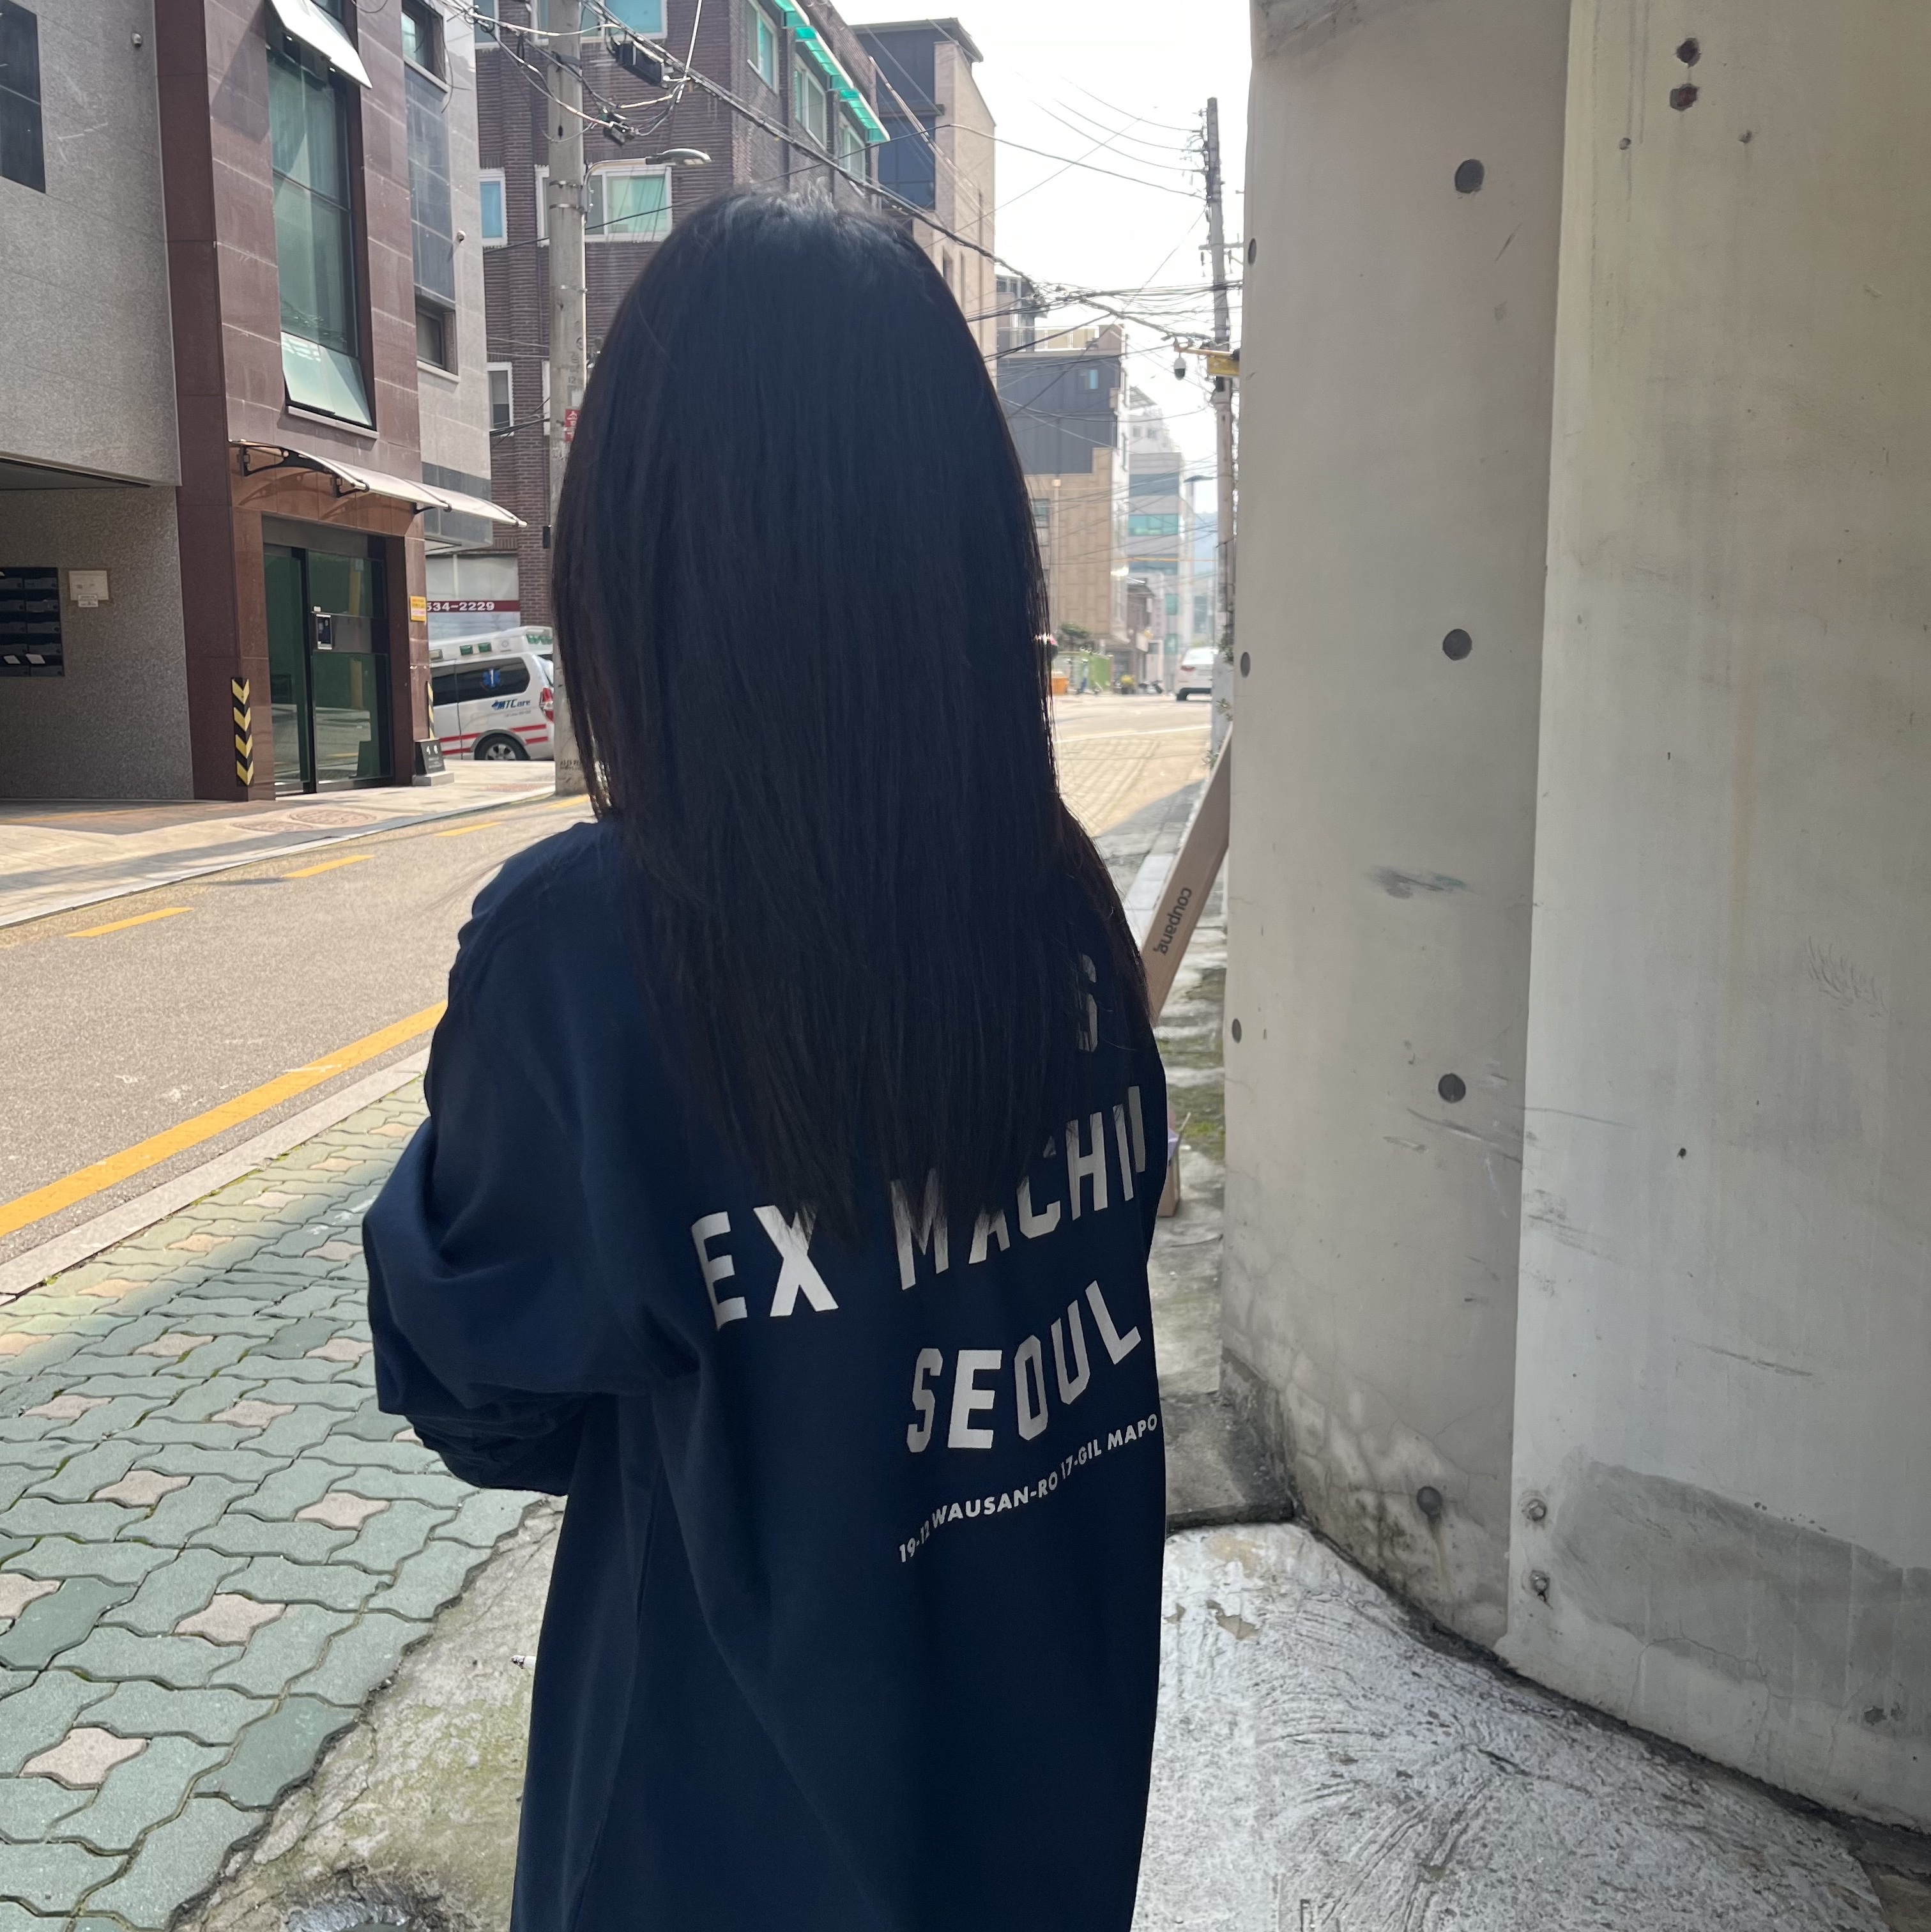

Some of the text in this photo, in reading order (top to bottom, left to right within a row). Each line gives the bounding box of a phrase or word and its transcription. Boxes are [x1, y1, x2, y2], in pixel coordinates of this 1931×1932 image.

[1153, 887, 1192, 956] coupang
[691, 1204, 839, 1331] EX
[907, 1280, 1141, 1453] SEOUL
[932, 1471, 1058, 1528] WAUSAN-RO
[1061, 1439, 1102, 1480] 17-GIL
[1108, 1413, 1157, 1450] MAPO
